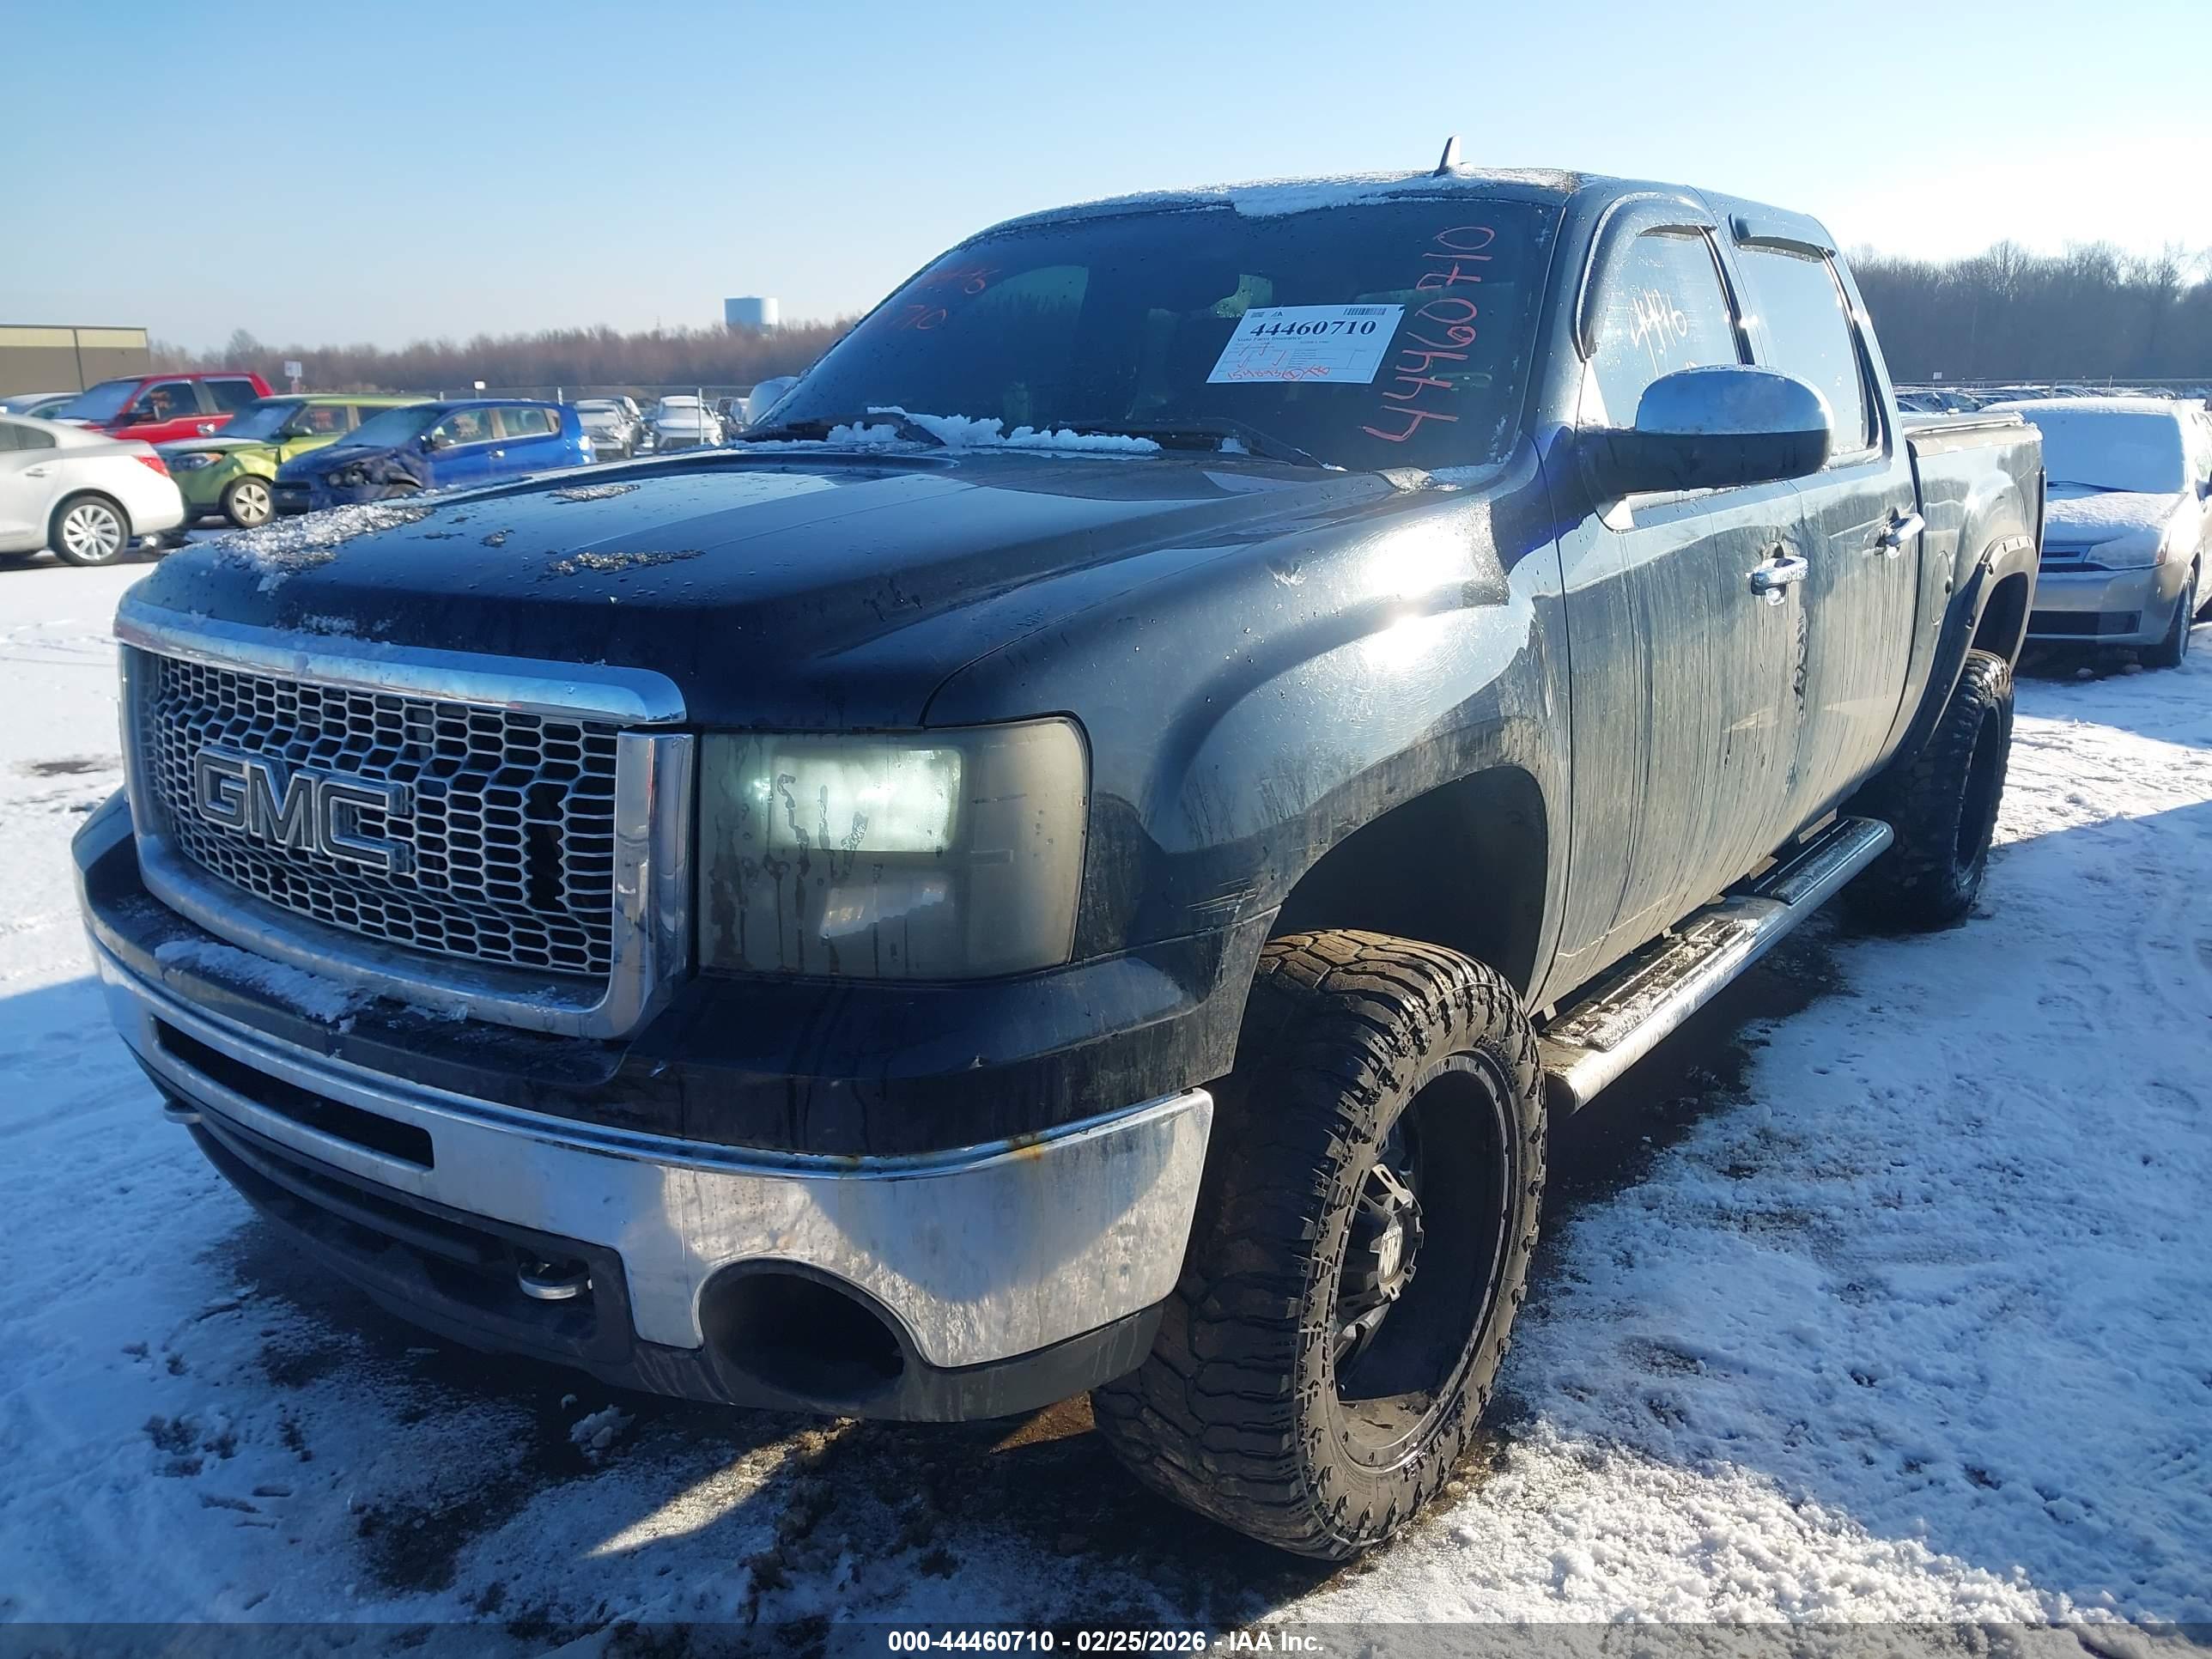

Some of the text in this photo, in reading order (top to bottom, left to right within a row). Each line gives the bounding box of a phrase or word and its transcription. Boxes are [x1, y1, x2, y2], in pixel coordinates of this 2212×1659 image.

[1250, 320, 1376, 337] 44460710
[1357, 227, 1496, 442] 44460710
[194, 744, 410, 874] GMC
